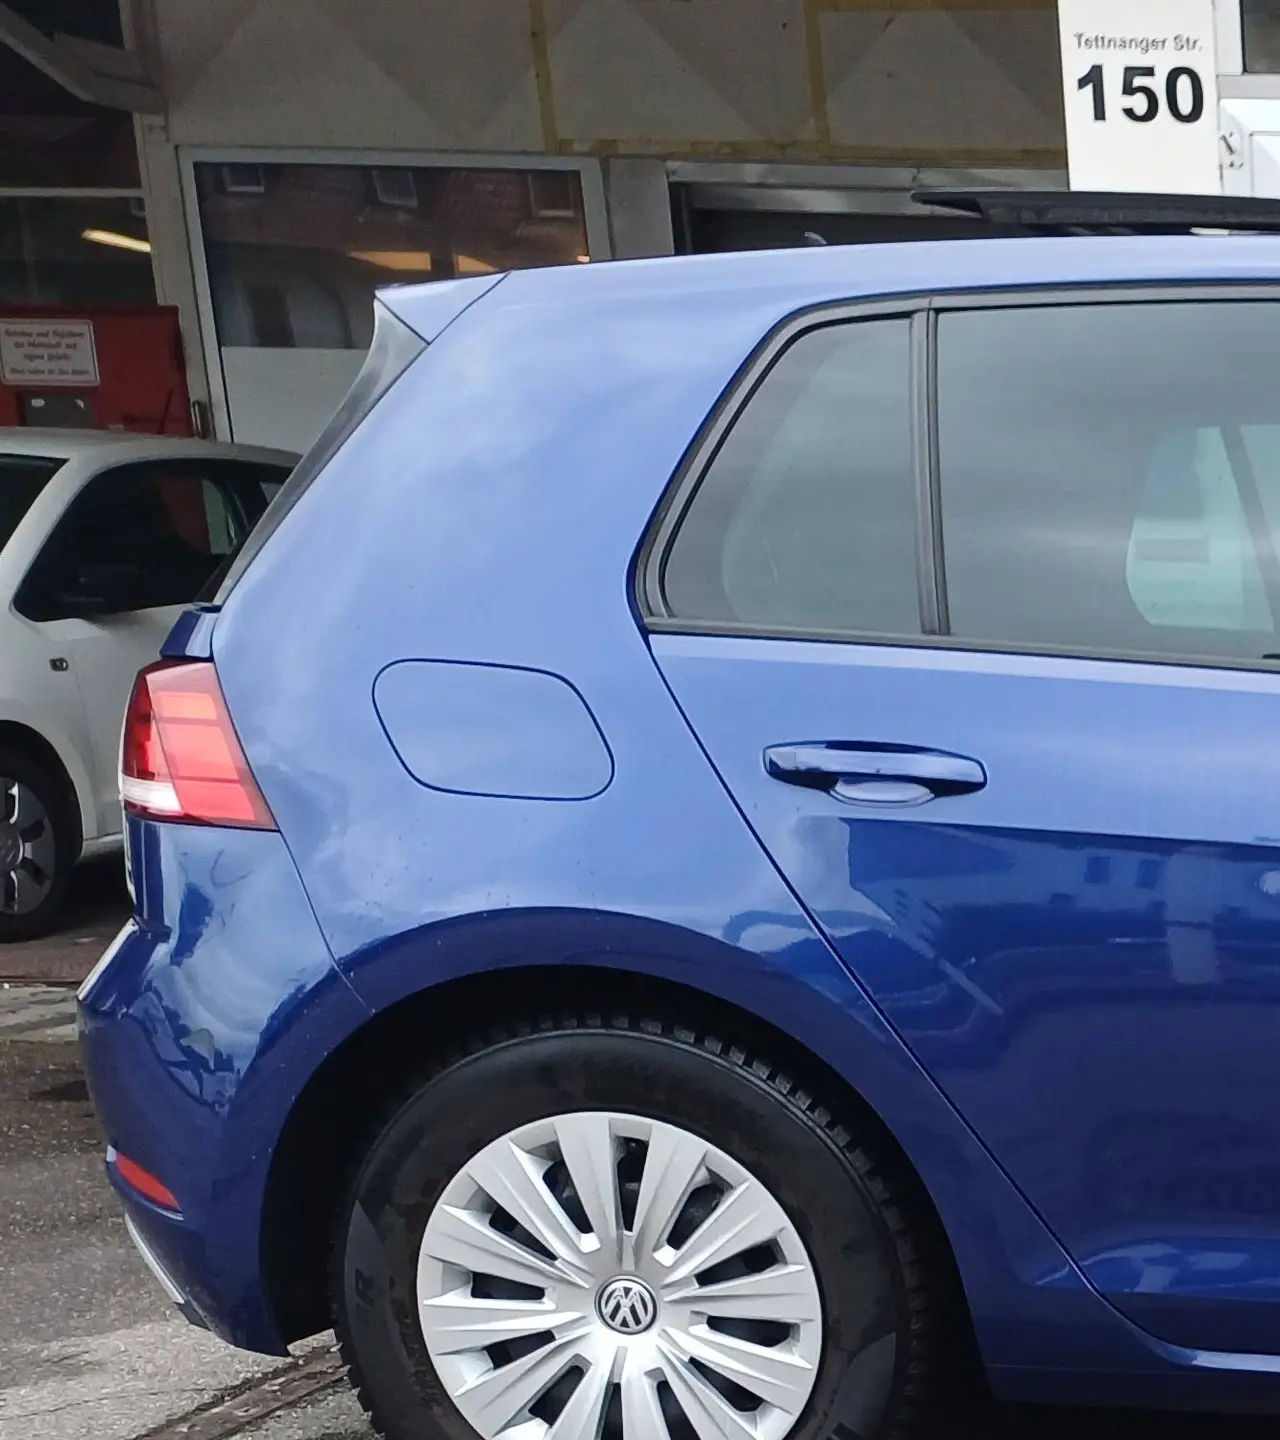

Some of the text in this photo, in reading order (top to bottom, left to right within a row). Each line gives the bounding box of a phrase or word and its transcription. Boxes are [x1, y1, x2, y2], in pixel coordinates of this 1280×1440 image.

[1073, 33, 1203, 54] Tettnanger Str.
[1077, 64, 1204, 124] 150
